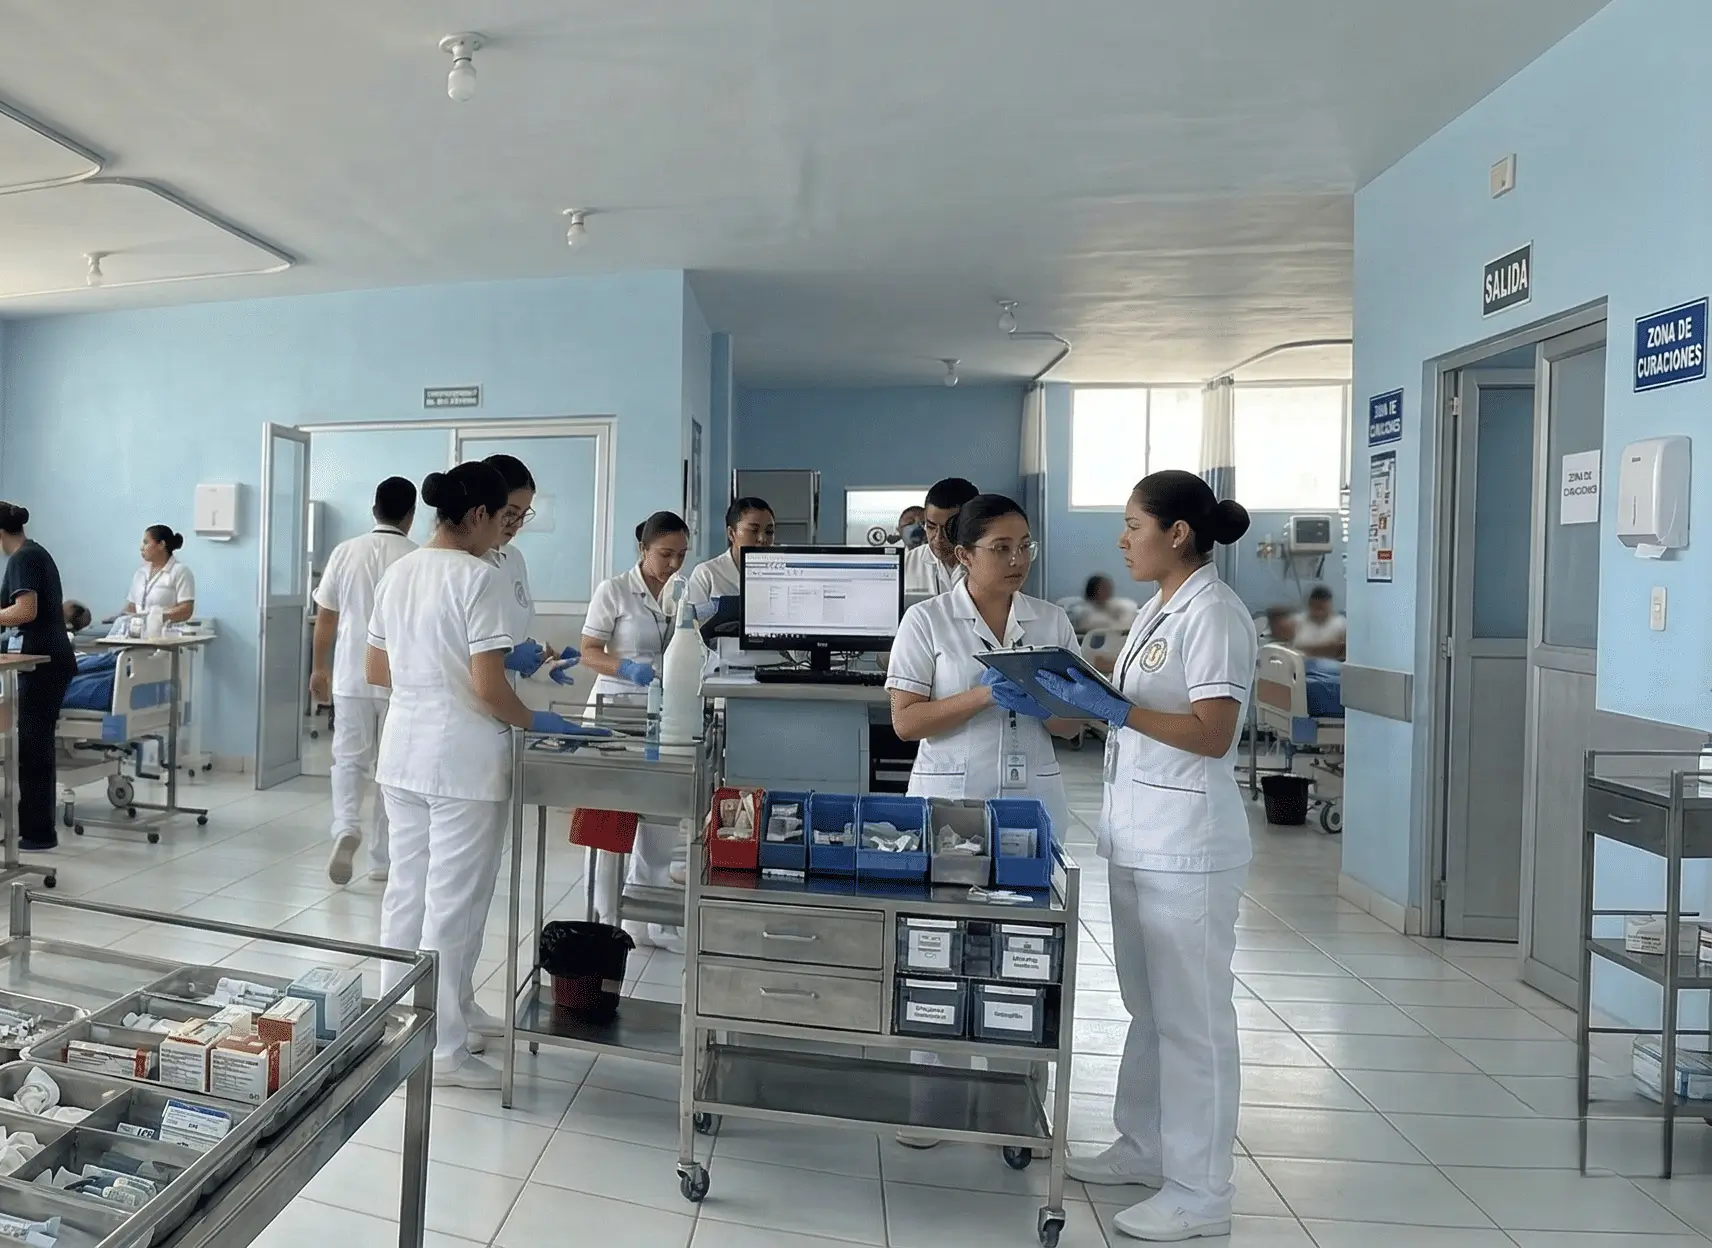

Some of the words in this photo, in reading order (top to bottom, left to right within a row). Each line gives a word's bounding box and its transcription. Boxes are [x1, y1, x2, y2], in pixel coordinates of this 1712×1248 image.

[1485, 258, 1528, 304] SALIDA
[1647, 321, 1676, 349] ZONA
[1678, 316, 1692, 341] DE
[1637, 343, 1703, 379] CURACIONES
